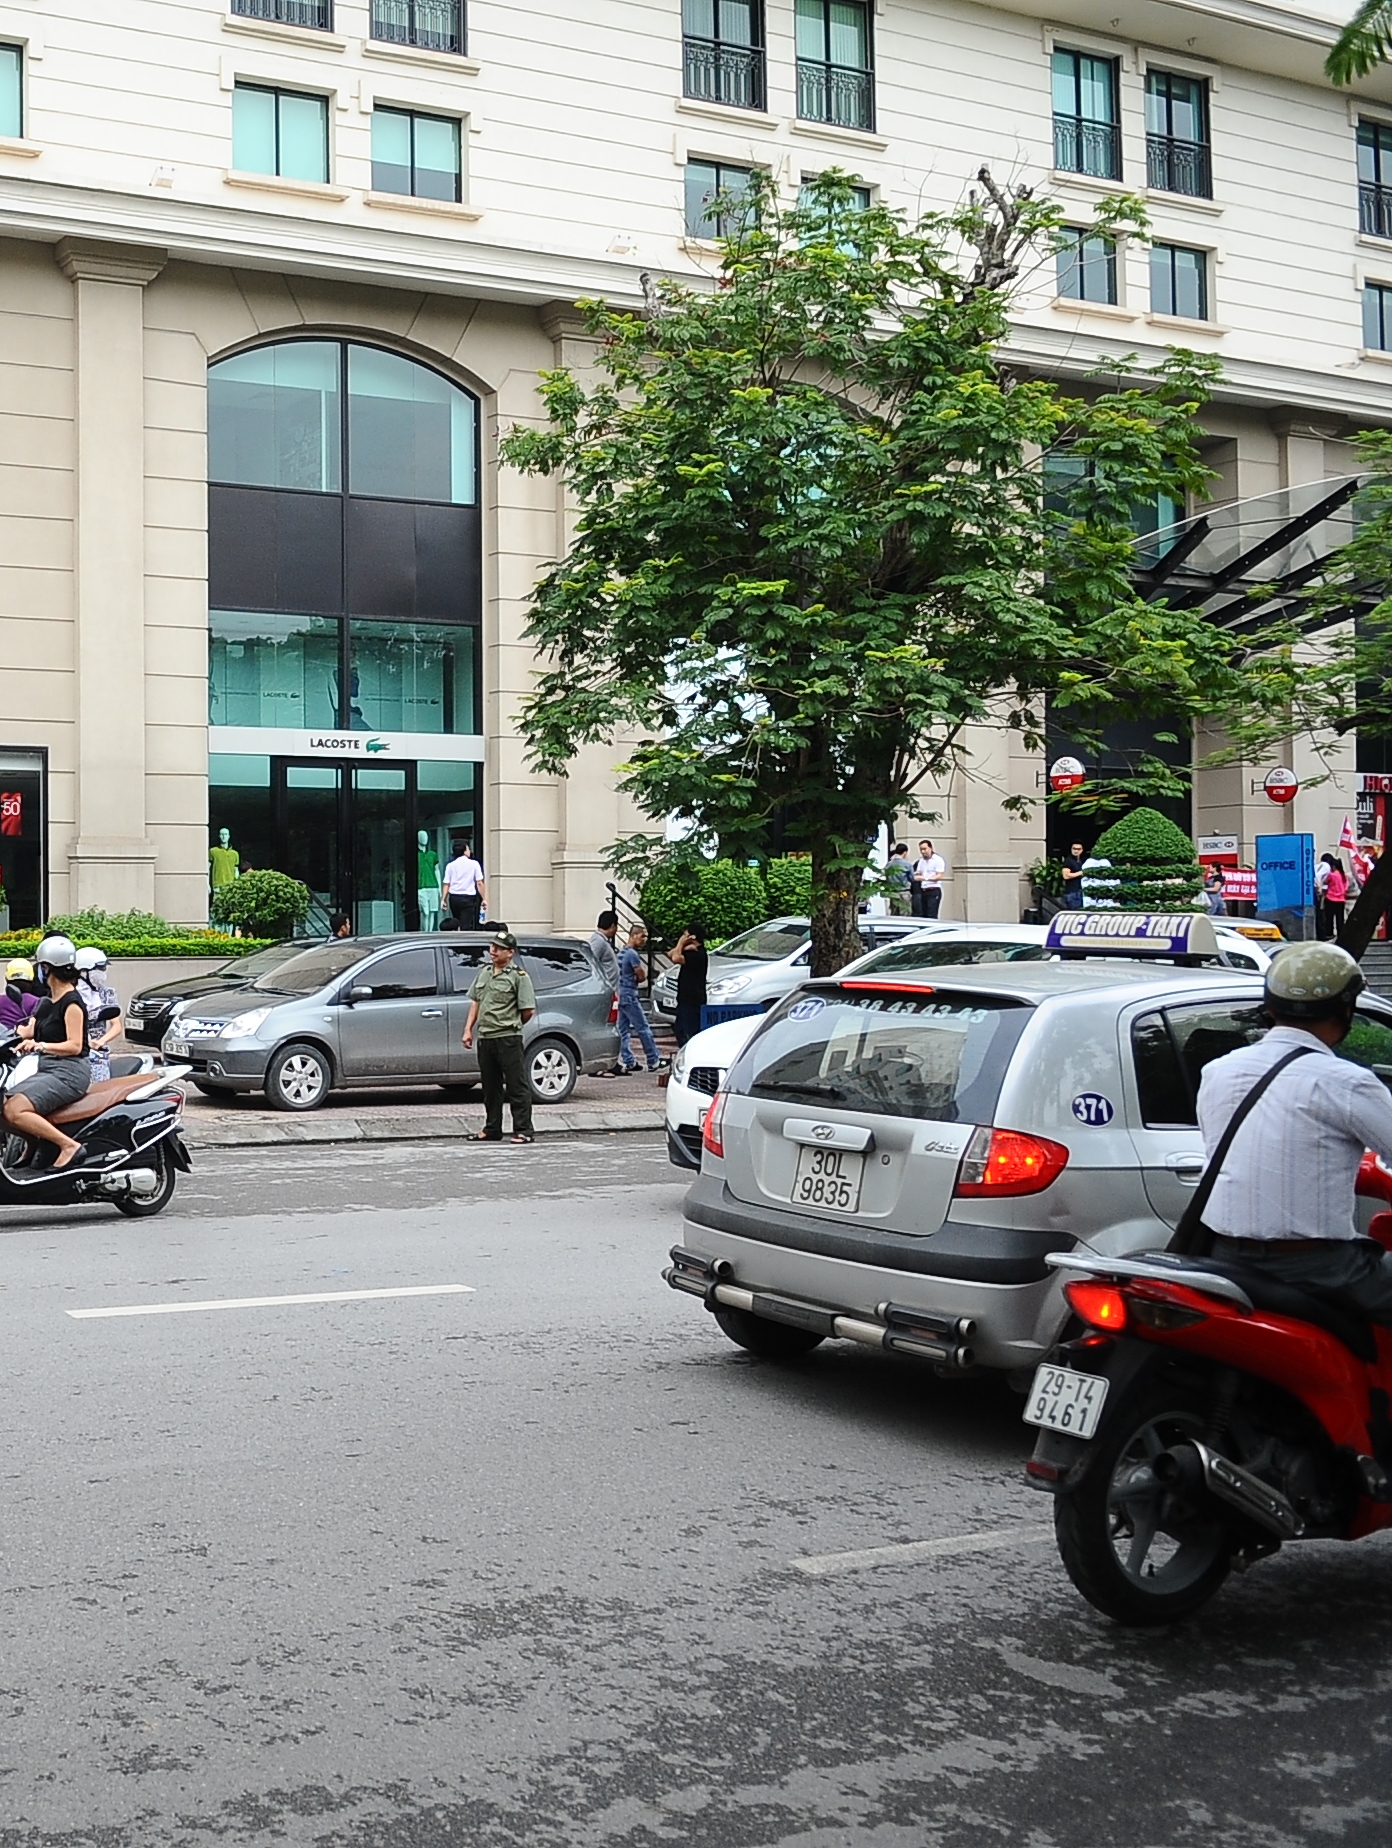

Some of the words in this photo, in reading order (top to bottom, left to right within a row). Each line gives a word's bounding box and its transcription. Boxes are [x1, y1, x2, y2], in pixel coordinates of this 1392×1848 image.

[310, 737, 360, 750] LACOSTE
[1202, 840, 1223, 850] HSBC
[1260, 860, 1296, 871] OFFICE
[1304, 847, 1312, 896] OFFICE
[1054, 913, 1086, 935] VIC
[791, 999, 821, 1018] 371
[855, 998, 884, 1013] 38
[887, 1001, 917, 1016] 43
[920, 1003, 952, 1019] 43
[956, 1007, 989, 1024] 43
[1074, 1097, 1109, 1122] 371
[811, 1150, 848, 1180] 30L
[799, 1176, 853, 1208] 9835
[1041, 1370, 1095, 1405] 29-T4
[1034, 1396, 1089, 1433] 9461
